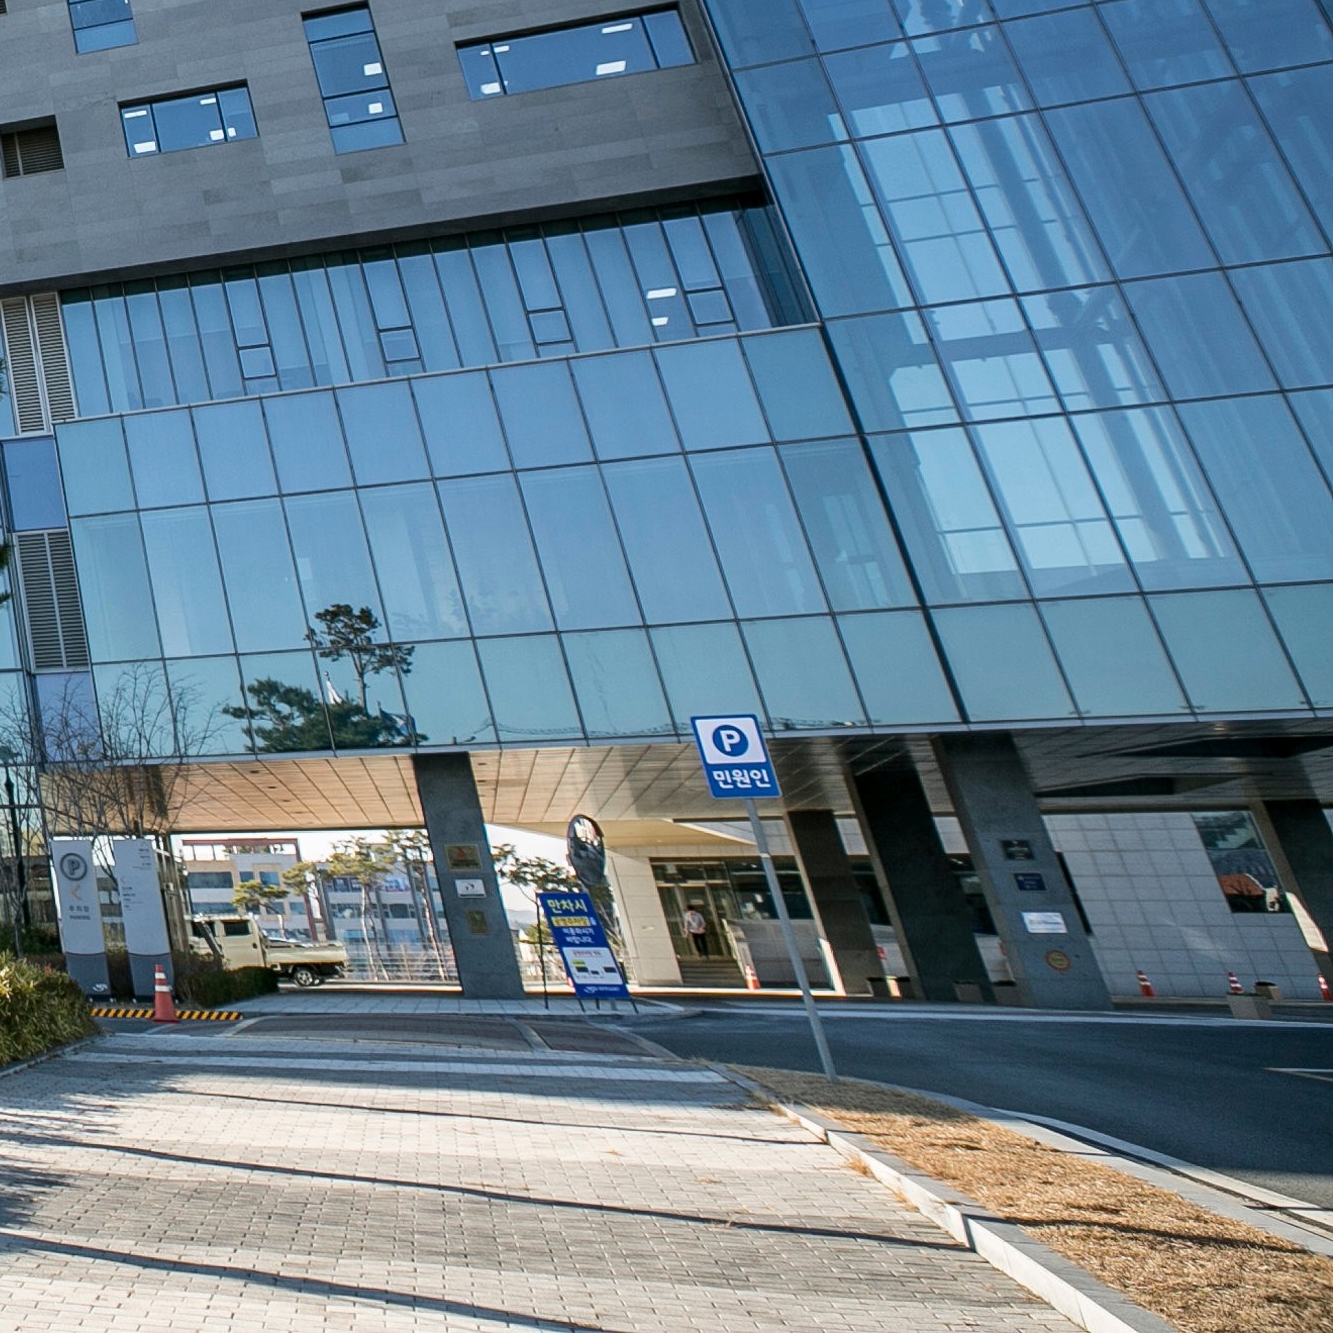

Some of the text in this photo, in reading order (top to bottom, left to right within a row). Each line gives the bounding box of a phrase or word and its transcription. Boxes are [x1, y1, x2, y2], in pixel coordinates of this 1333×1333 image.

[719, 730, 741, 752] P
[712, 768, 771, 789] 민원인
[68, 859, 81, 875] P
[546, 898, 589, 914] 만차시
